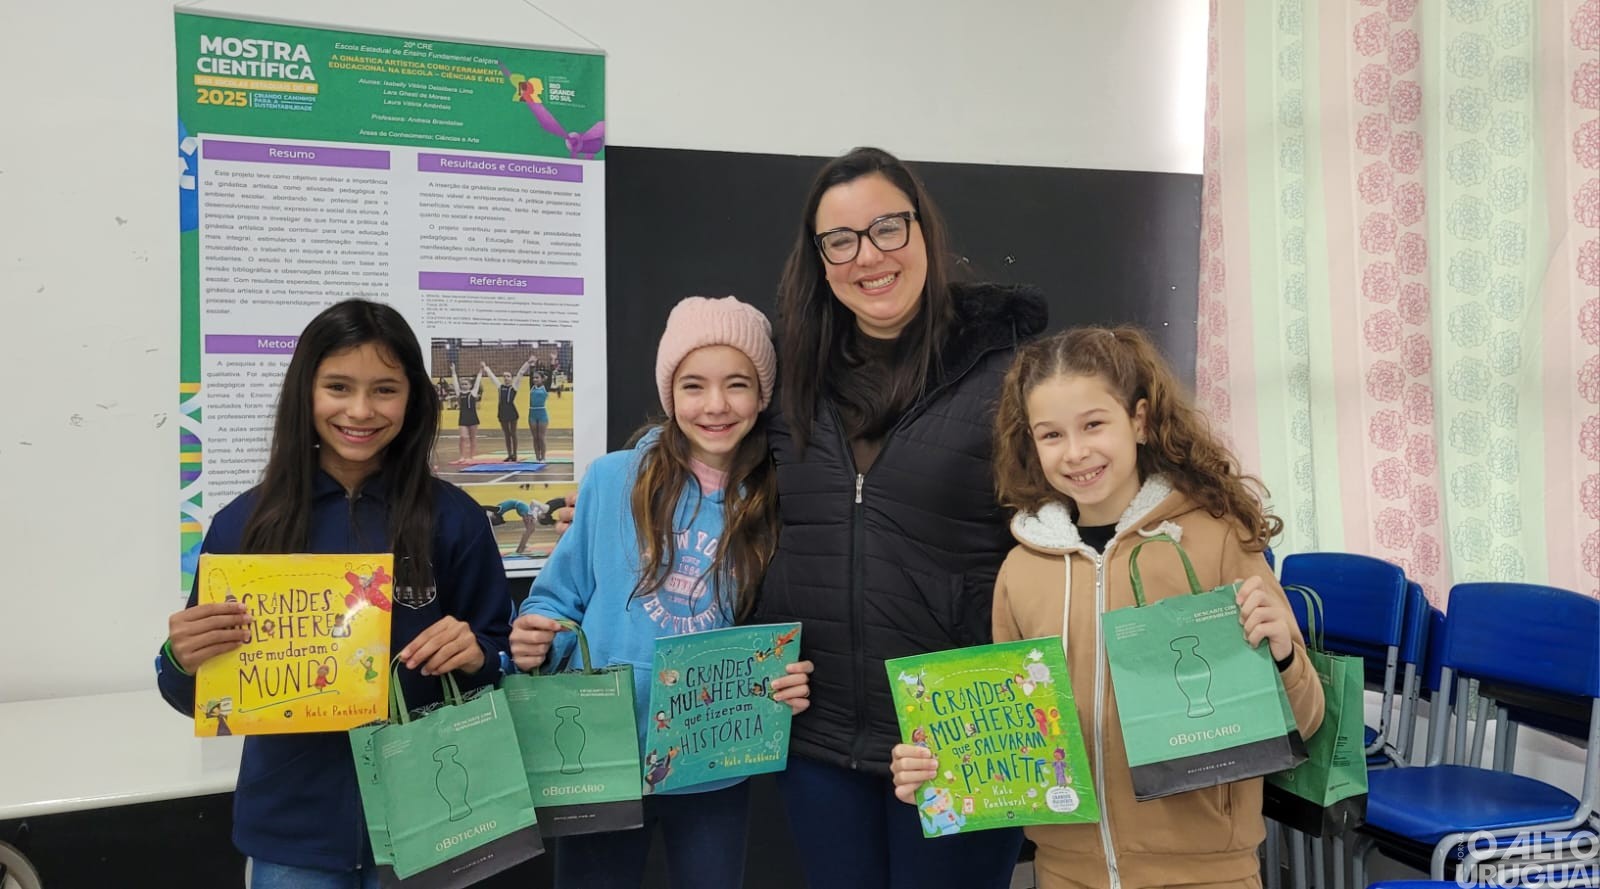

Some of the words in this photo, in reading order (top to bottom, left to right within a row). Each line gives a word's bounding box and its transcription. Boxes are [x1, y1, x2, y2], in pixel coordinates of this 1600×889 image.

[201, 35, 311, 63] MOSTRA
[335, 42, 359, 51] Escola
[360, 45, 392, 55] Estadual
[403, 49, 427, 57] Ensino
[428, 51, 472, 62] Fundamental
[197, 57, 316, 81] CIENTÍFICA
[328, 61, 385, 73] EDUCACIONAL
[401, 68, 433, 77] ESCOLA
[441, 70, 476, 81] CIÊNCIAS
[485, 76, 505, 84] ARTE
[340, 54, 383, 64] GINÁSTICA
[385, 58, 426, 69] ARTÍSTICA
[427, 63, 450, 71] COMO
[452, 65, 504, 76] FERRAMENTA
[197, 88, 248, 107] 2025
[549, 89, 576, 97] GRANDE
[268, 148, 316, 160] Resumo
[440, 158, 497, 171] Resultados
[508, 163, 558, 176] Conclusão
[469, 277, 528, 287] Referências
[242, 588, 332, 617] GRANDES
[239, 649, 263, 663] que
[266, 641, 328, 661] mudaram
[331, 643, 339, 652] o
[239, 656, 338, 704] MUNDO
[686, 657, 755, 688] GRANDES
[670, 676, 770, 719] MULHERES
[931, 678, 1016, 716] GRANDES
[305, 704, 327, 718] Kate
[684, 715, 702, 730] que
[706, 703, 753, 722] fizeram
[680, 714, 764, 756] HISTÓRIA
[929, 703, 1036, 751] MULHERES
[951, 743, 971, 758] que
[974, 731, 1047, 756] SALVARAM
[961, 753, 1047, 793] PLANETA
[991, 784, 1014, 796] Kate
